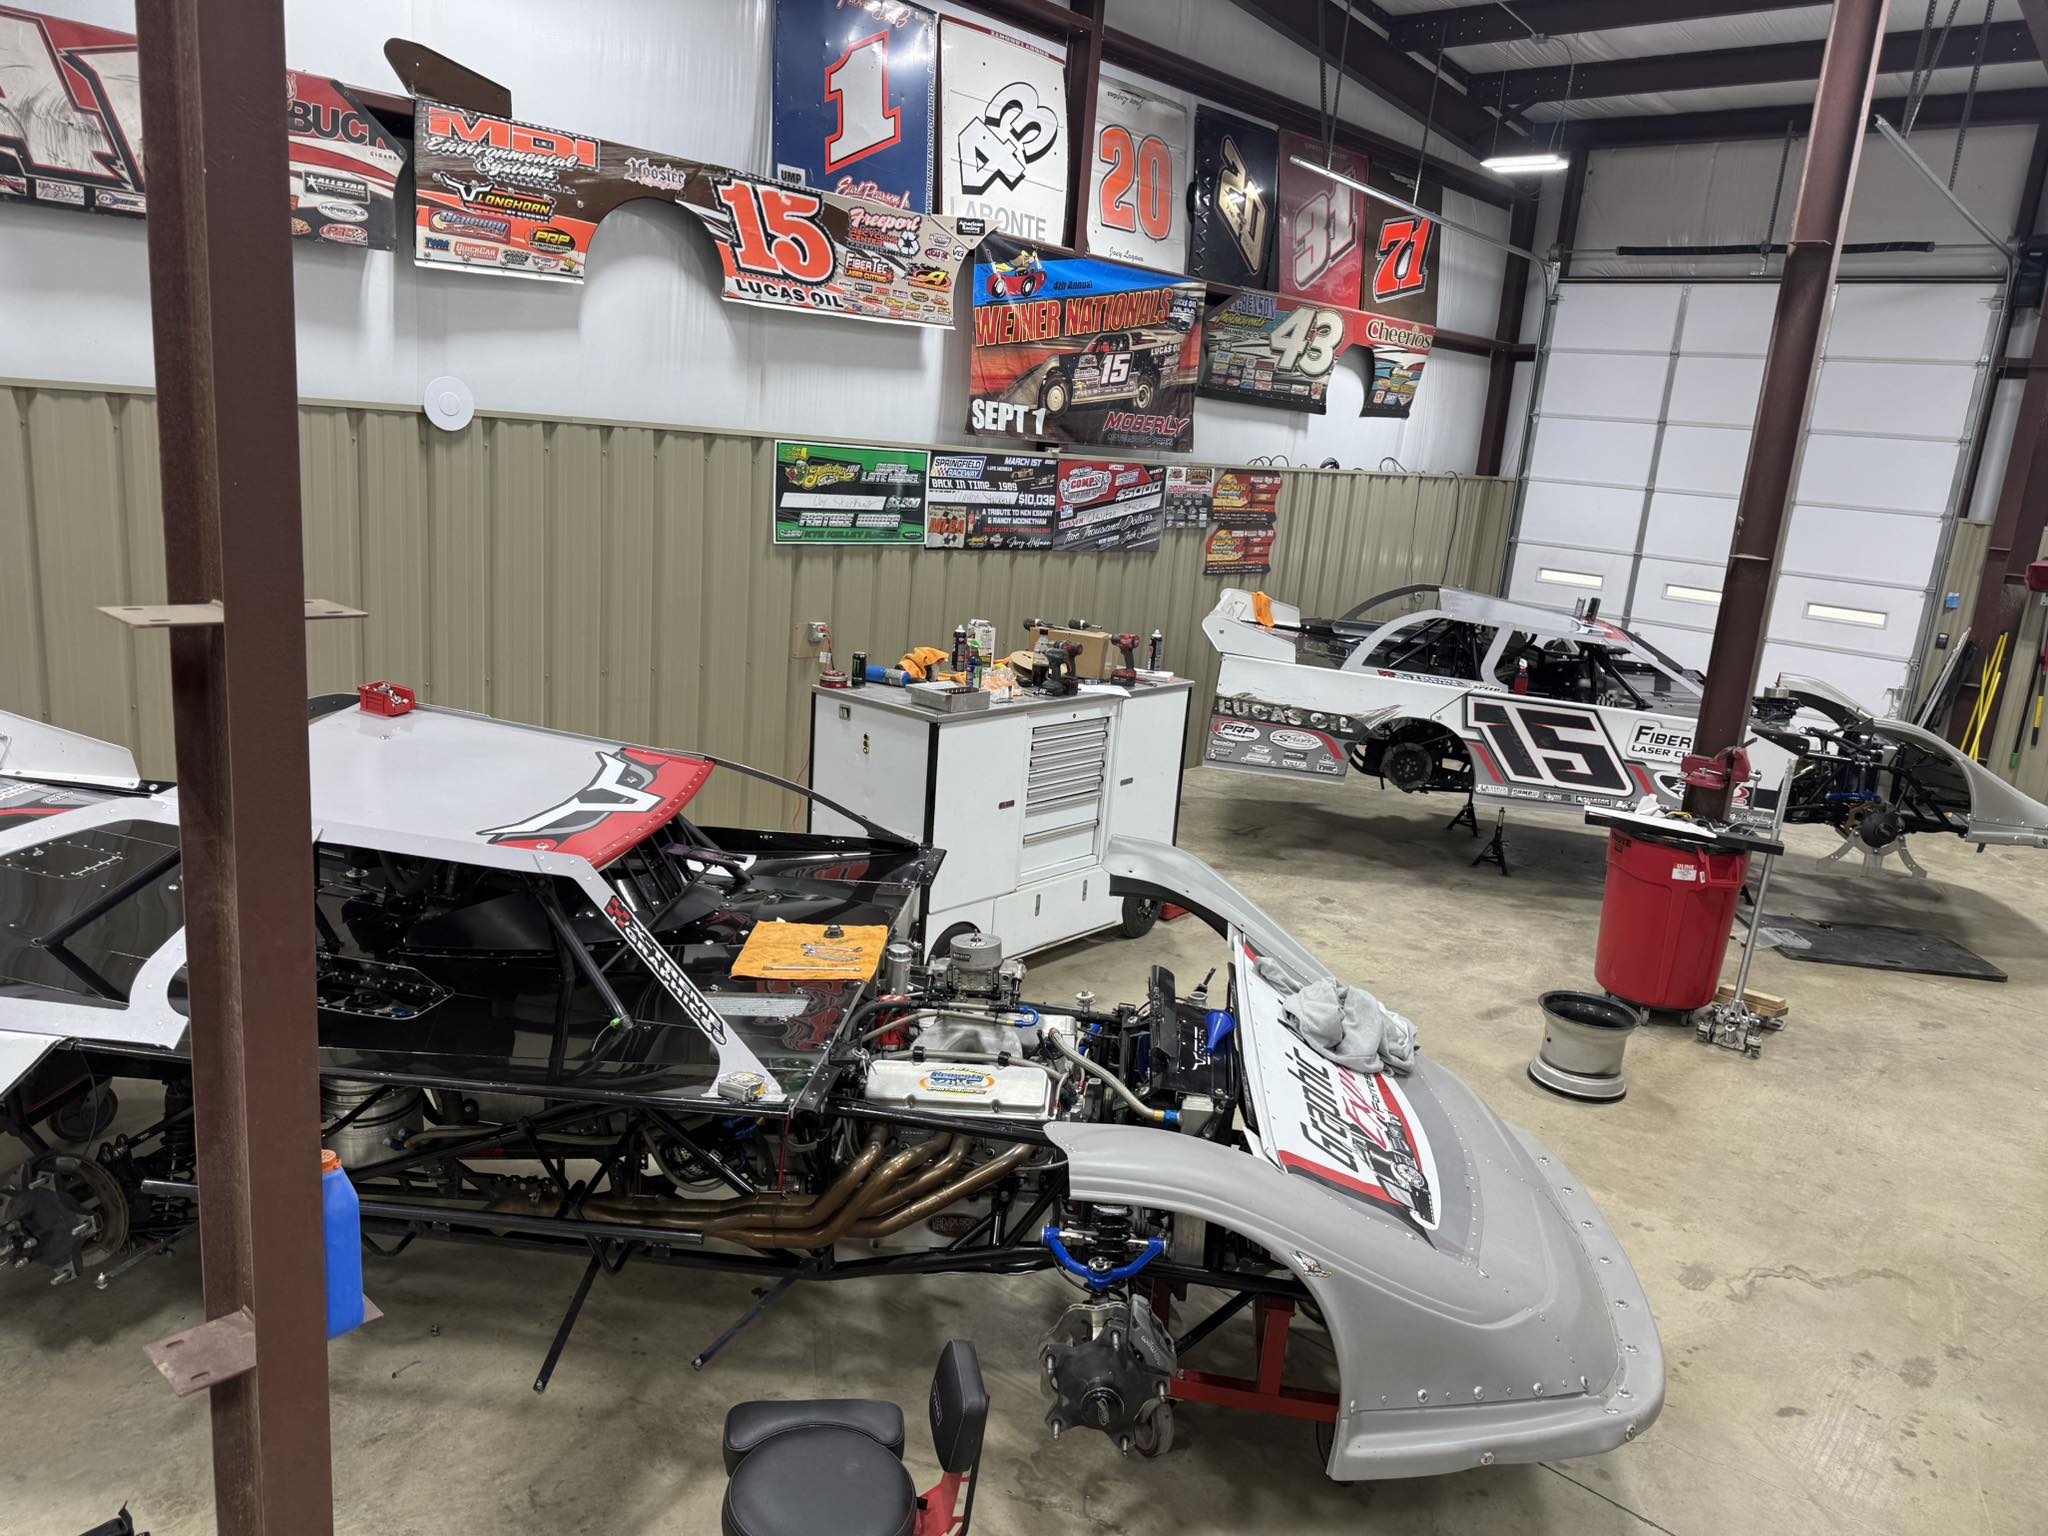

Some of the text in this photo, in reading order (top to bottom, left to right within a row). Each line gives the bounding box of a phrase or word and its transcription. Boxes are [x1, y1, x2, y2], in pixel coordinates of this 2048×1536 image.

[824, 30, 901, 175] 1
[426, 136, 578, 168] Environmental
[428, 106, 596, 168] MDI
[958, 81, 1061, 195] 43
[476, 156, 558, 180] Systems
[624, 157, 687, 190] Hoosier
[780, 169, 802, 184] UMP
[1099, 124, 1172, 241] 20
[316, 178, 366, 191] ALLSTAR
[476, 194, 550, 215] LONGHORN
[848, 206, 921, 233] Freeport
[718, 178, 836, 287] 15
[1374, 215, 1434, 303] 71
[734, 278, 805, 303] LUCAS
[811, 292, 844, 309] OIL
[1053, 279, 1093, 291] 4th Annual
[975, 299, 1061, 347] WEINER
[1065, 288, 1174, 338] NATIONALS
[1269, 305, 1344, 379] 43
[1367, 319, 1433, 349] Cheerios
[1151, 345, 1172, 356] LUCAS
[1100, 352, 1132, 385] 15
[972, 399, 1046, 435] SEPT 1
[1103, 411, 1190, 437] MOBERLY
[935, 458, 982, 469] SPRINGFIELD
[947, 469, 980, 478] RACEWAY
[1004, 457, 1029, 466] MARCH
[981, 508, 986, 516] A
[987, 508, 1012, 516] TRIBUTE
[1018, 492, 1056, 507] $10,036
[1080, 519, 1121, 539] Thousand
[1121, 514, 1153, 531] Dollars
[1219, 699, 1303, 726] LUCAS
[1474, 702, 1628, 791] 15
[1631, 745, 1671, 756] LASER
[1634, 725, 1692, 748] FIBER
[625, 927, 728, 1046] GRAPHICS
[631, 921, 723, 1030] XTREME
[1366, 1073, 1382, 1111] Forres
[1285, 1046, 1359, 1173] Graphic
